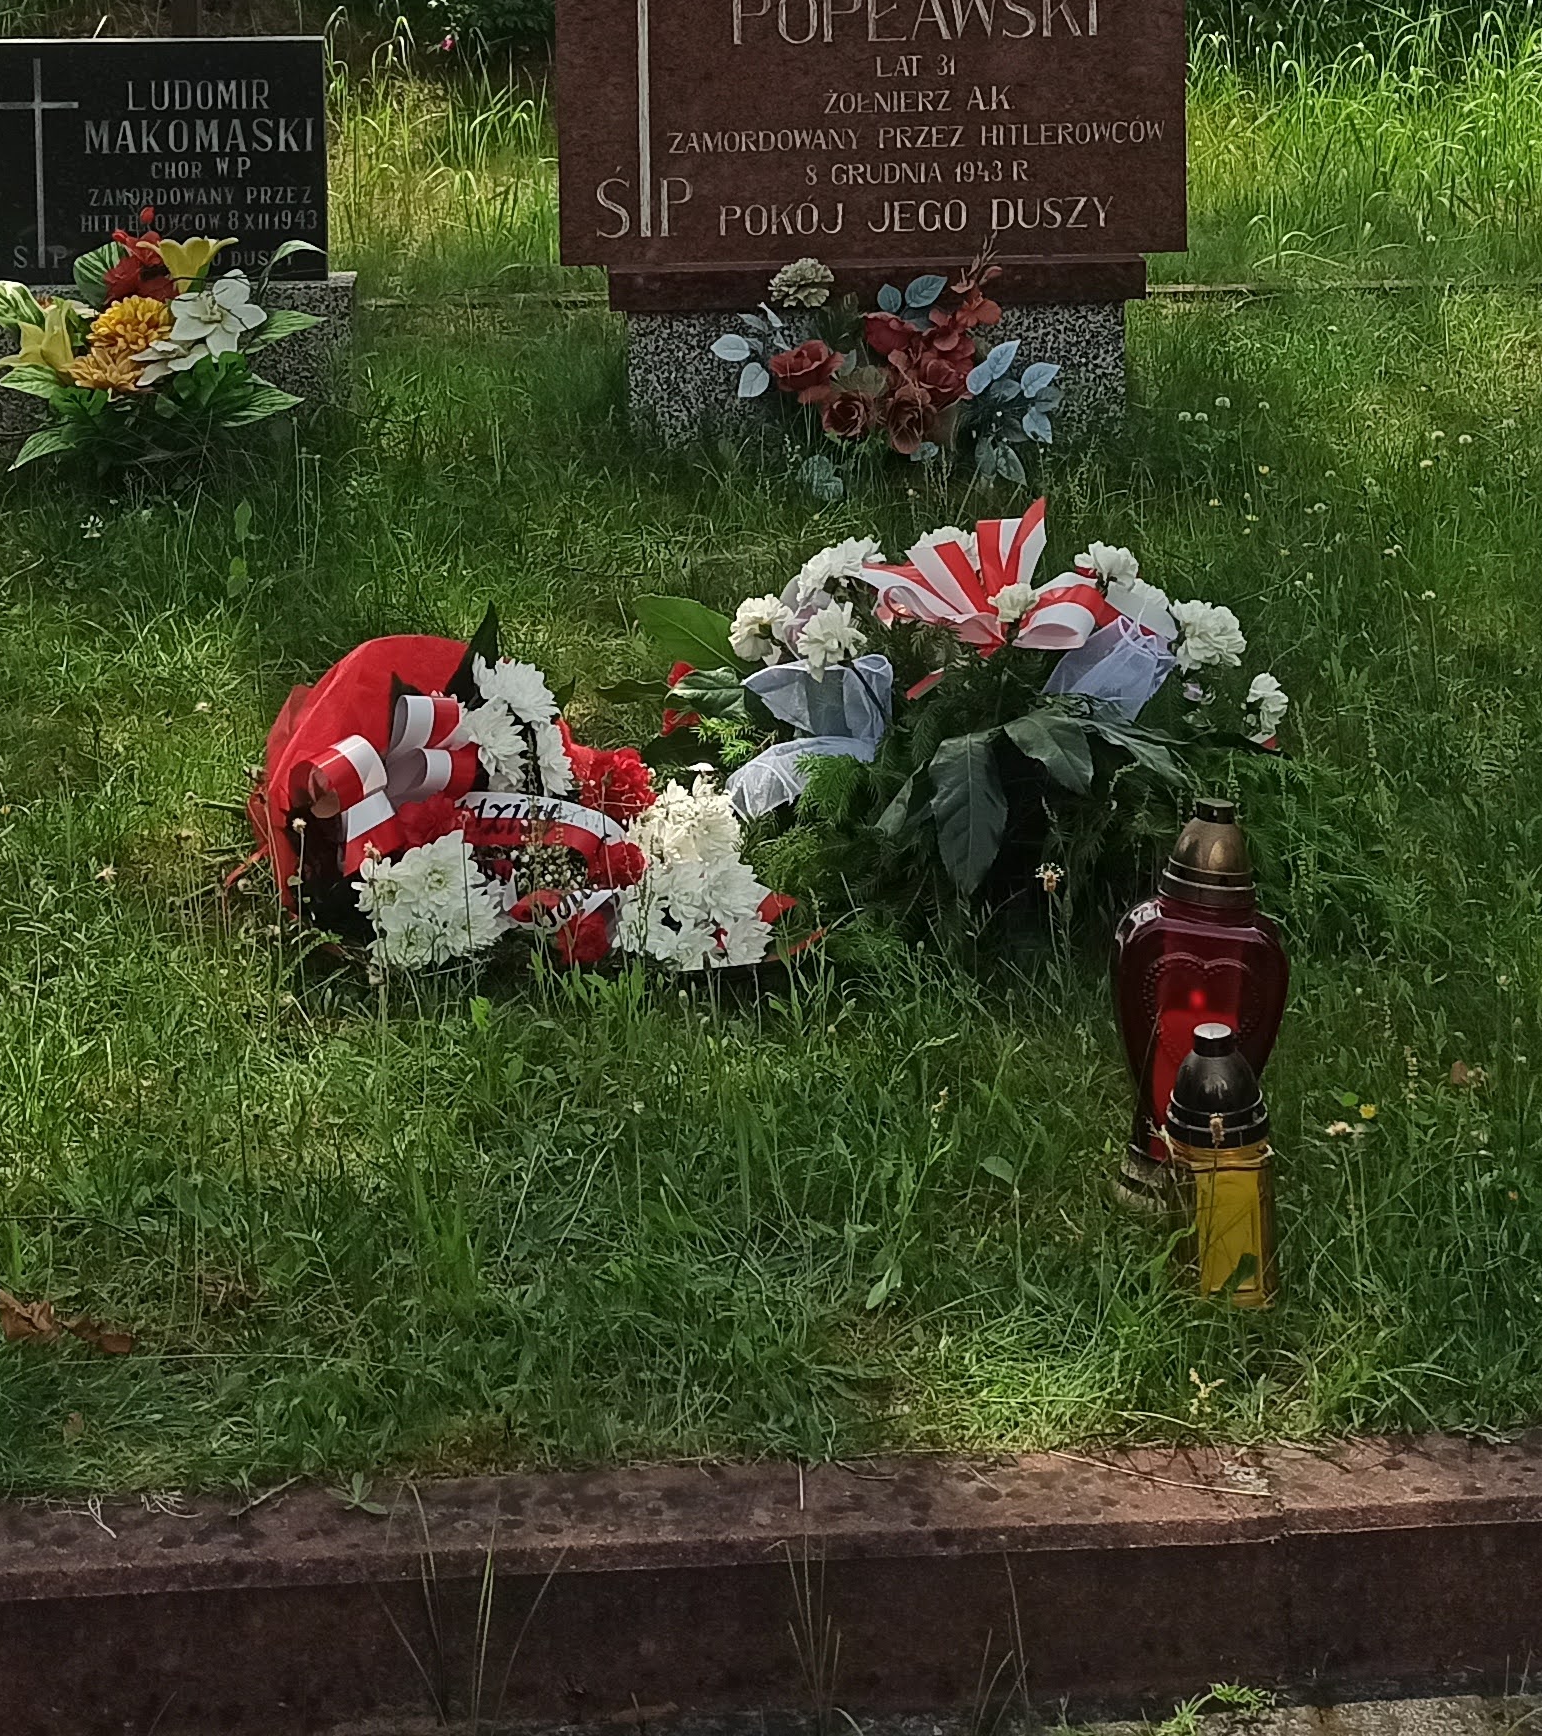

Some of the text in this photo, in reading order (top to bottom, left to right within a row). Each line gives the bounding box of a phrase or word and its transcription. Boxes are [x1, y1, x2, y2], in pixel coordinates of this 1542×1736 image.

[876, 54, 957, 78] LAT 31
[127, 79, 271, 111] LUDOMIR
[823, 86, 951, 114] ŻOŁNIERZ
[84, 117, 316, 154] MAKOMASKI
[667, 116, 1167, 155] ZAMORDOWANY PRZEZ HITLEROWCÓW
[151, 161, 203, 179] CHOR
[804, 164, 818, 185] 8
[831, 163, 944, 185] GRUDNIA
[955, 162, 1003, 183] 1943
[89, 186, 312, 207] ZAMORDOWANY PRZEZ
[228, 210, 239, 230] 8
[718, 196, 844, 237] POKÓJ
[867, 200, 968, 234] JEGO
[991, 196, 1115, 231] DUSZY
